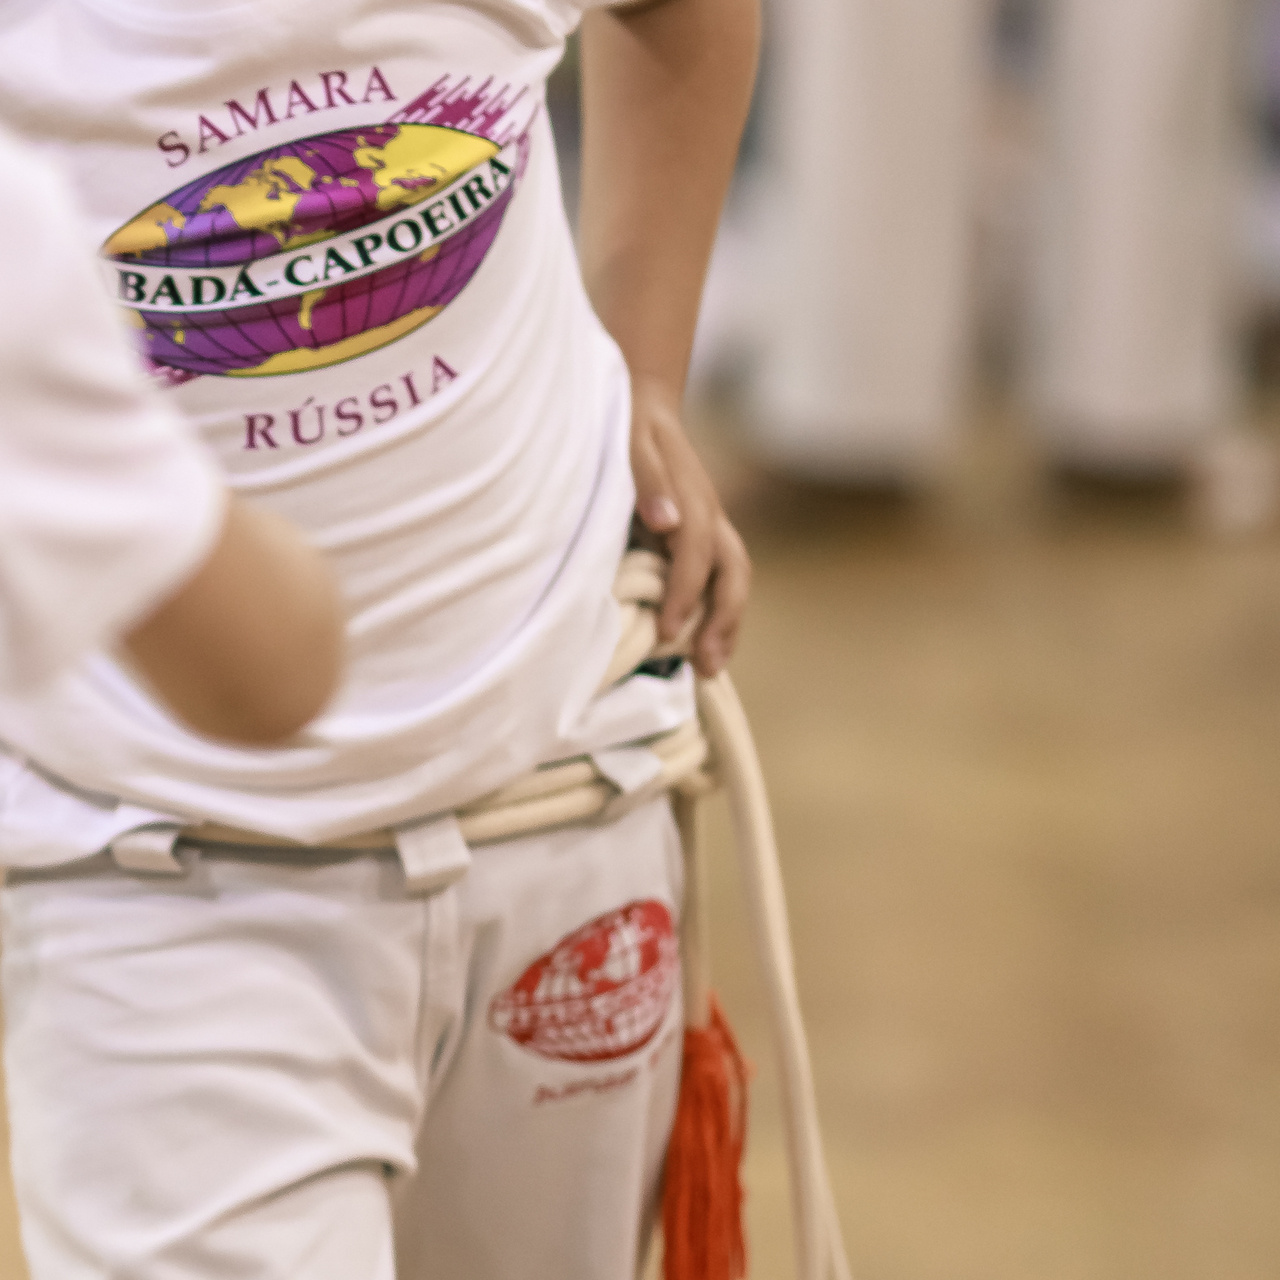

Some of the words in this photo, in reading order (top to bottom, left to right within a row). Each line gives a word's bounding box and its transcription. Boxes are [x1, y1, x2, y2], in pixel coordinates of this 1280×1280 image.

[156, 66, 397, 168] SAMARA
[119, 157, 511, 307] BADÁ-CAPOEIRA
[243, 354, 460, 450] RÚSSIA
